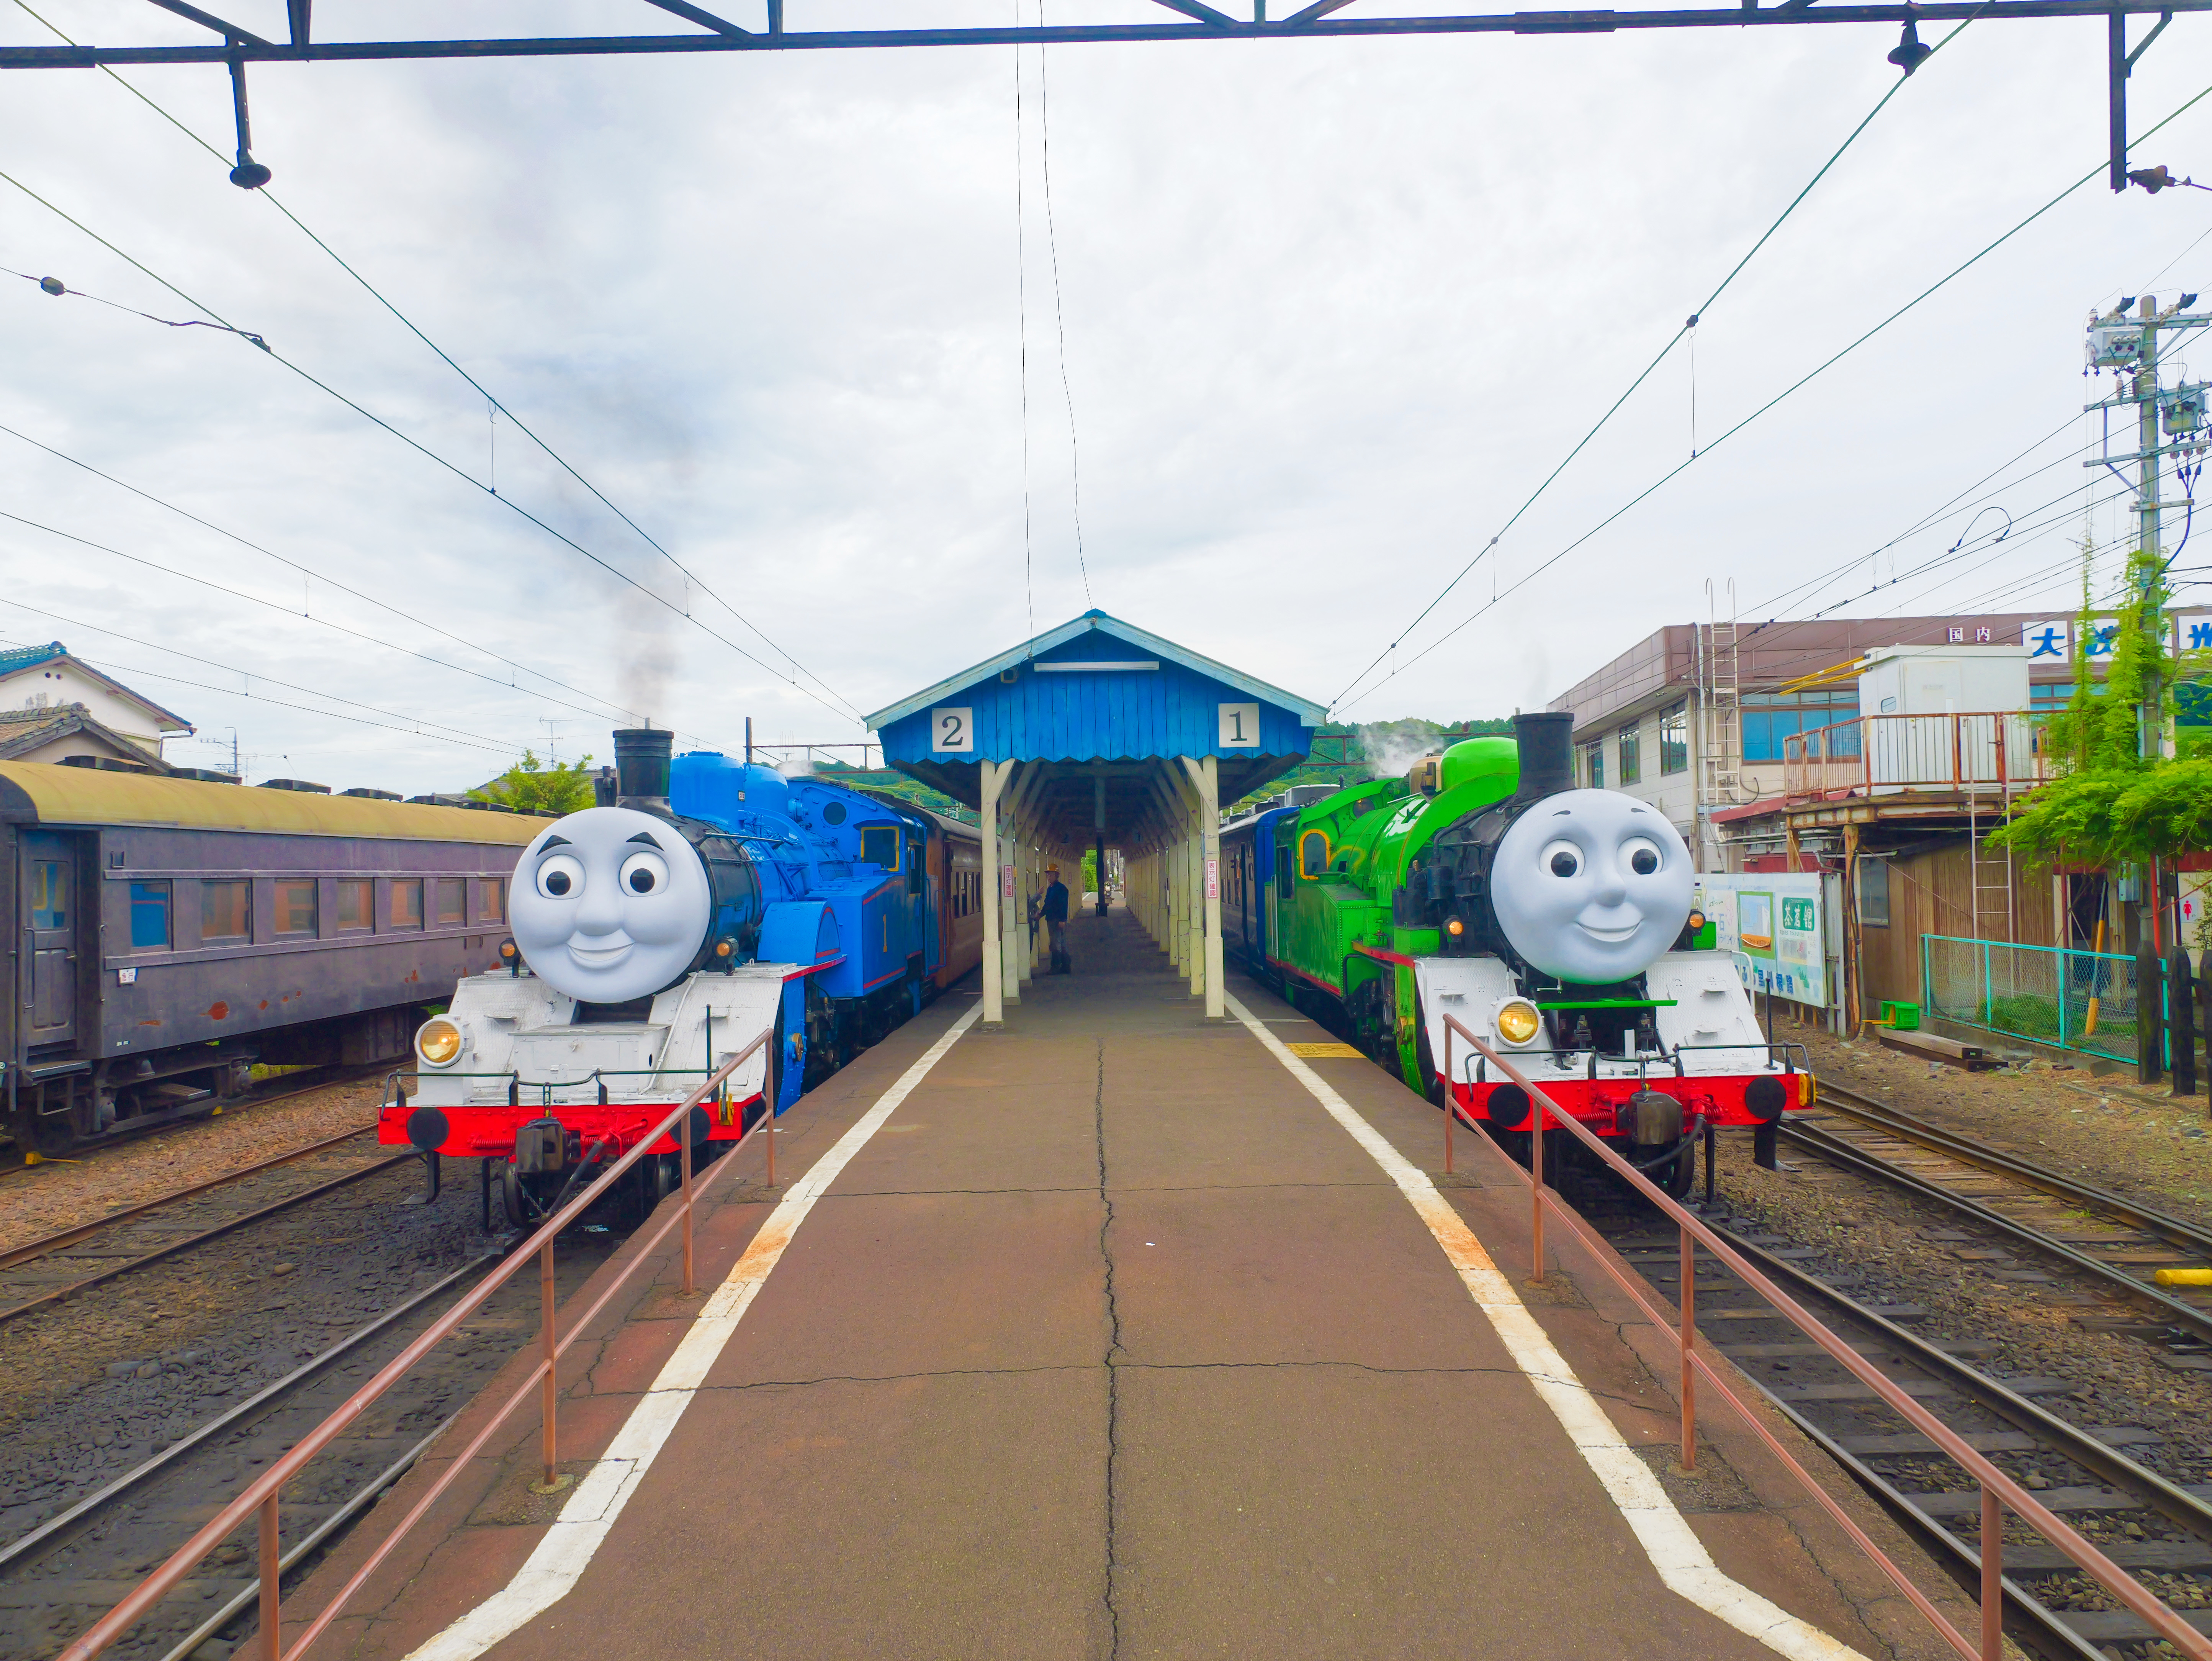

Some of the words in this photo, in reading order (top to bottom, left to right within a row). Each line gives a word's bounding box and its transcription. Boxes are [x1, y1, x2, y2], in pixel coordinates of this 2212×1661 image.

[1949, 627, 1990, 642] 国内
[942, 716, 963, 746] 2
[1229, 711, 1247, 741] 1
[883, 914, 887, 953] 1
